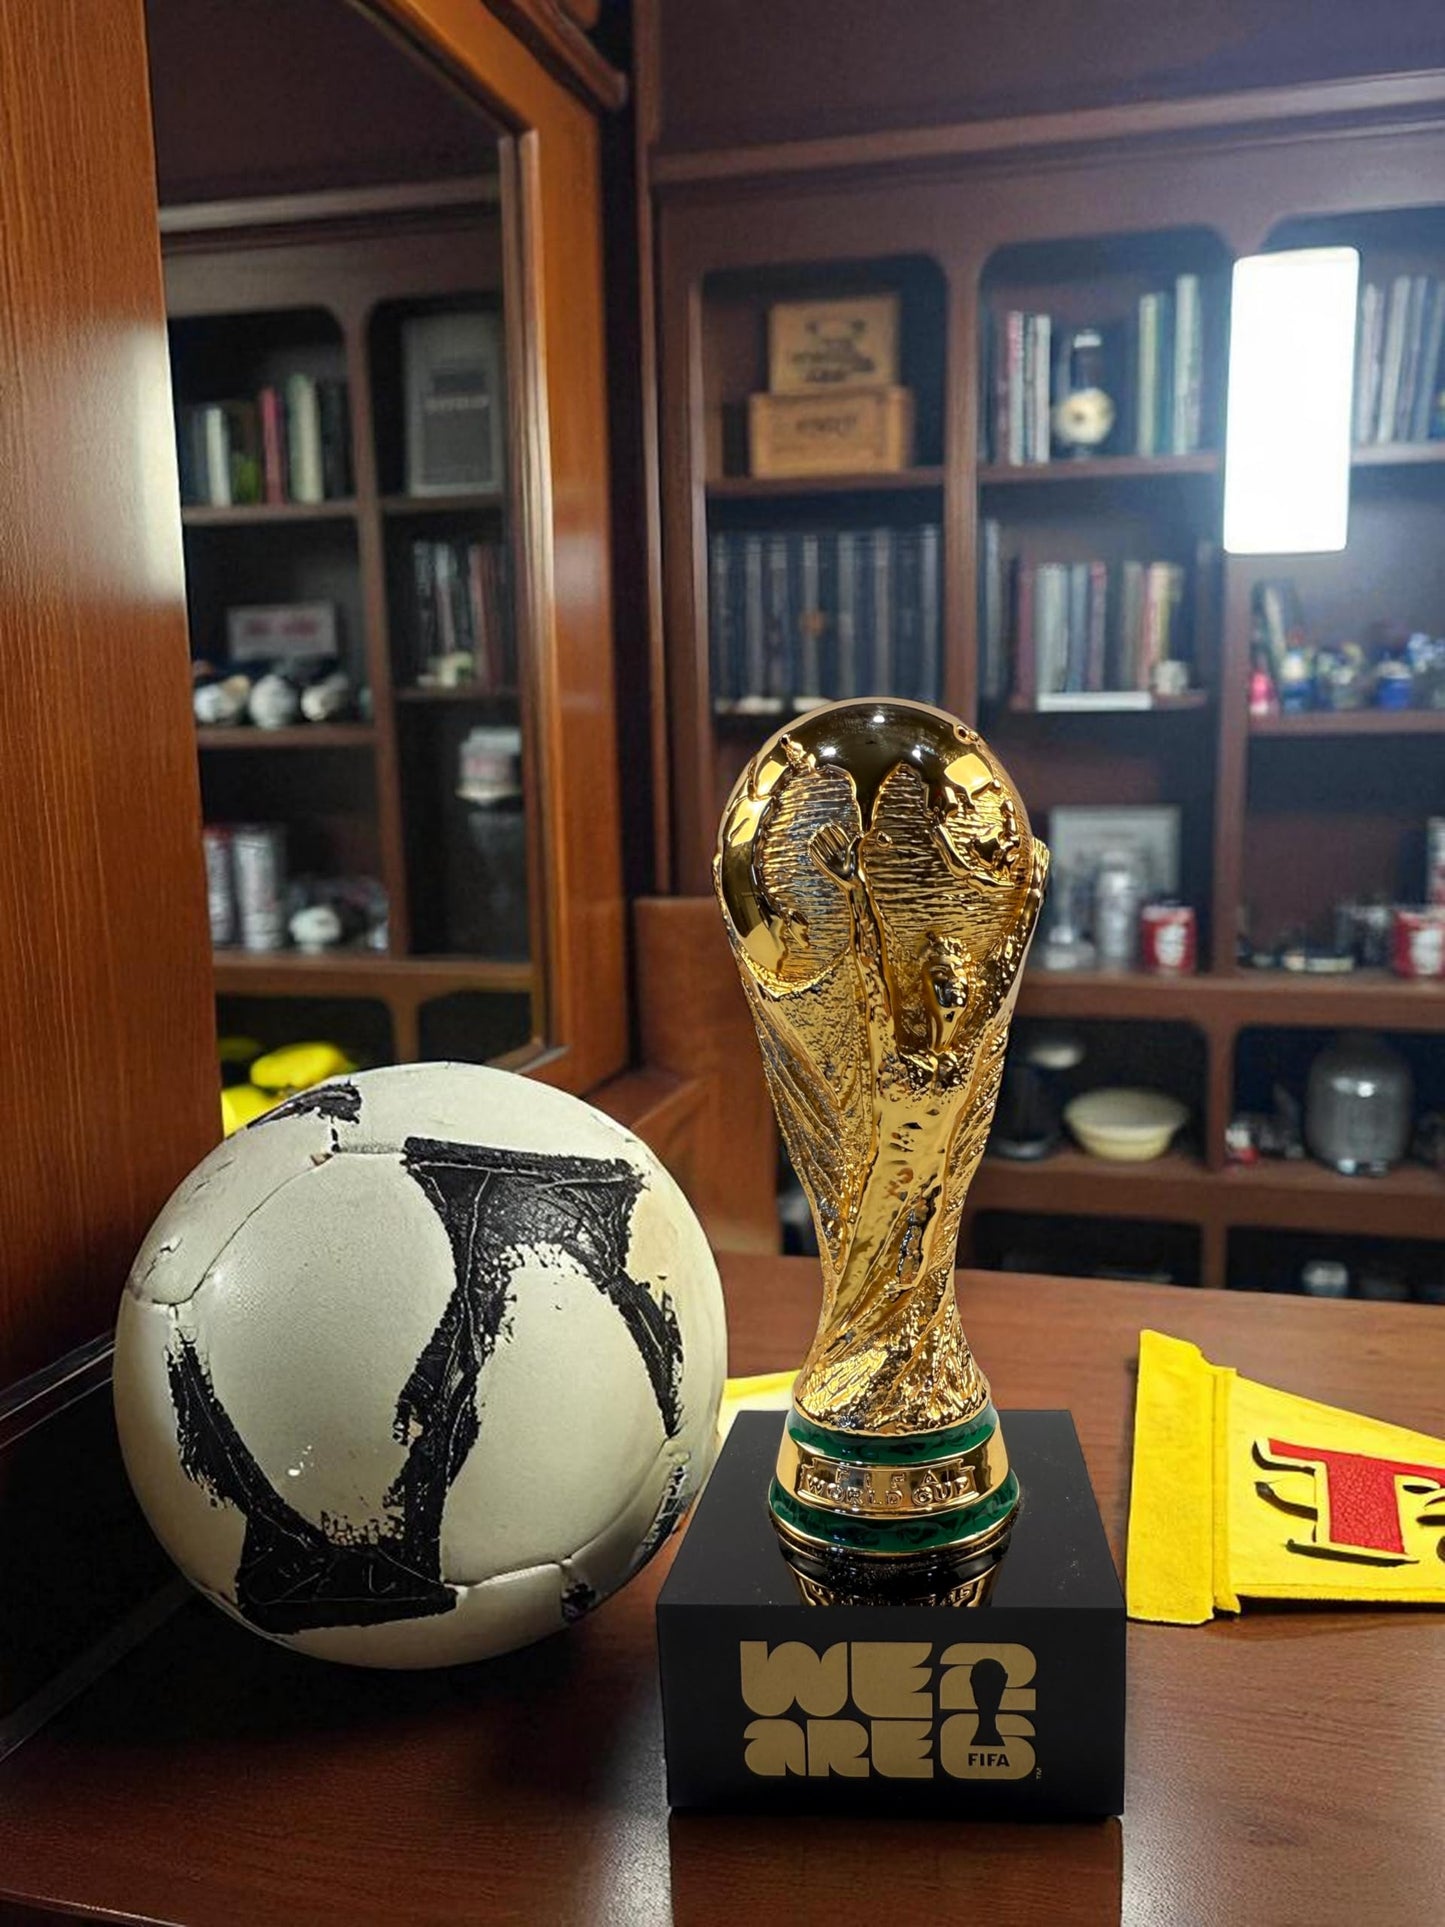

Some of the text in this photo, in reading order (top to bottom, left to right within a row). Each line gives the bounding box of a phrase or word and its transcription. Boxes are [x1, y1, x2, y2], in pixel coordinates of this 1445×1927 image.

[806, 1473, 969, 1506] WORLD CUP
[740, 1641, 933, 1719] WE
[968, 1753, 1010, 1767] FIFA
